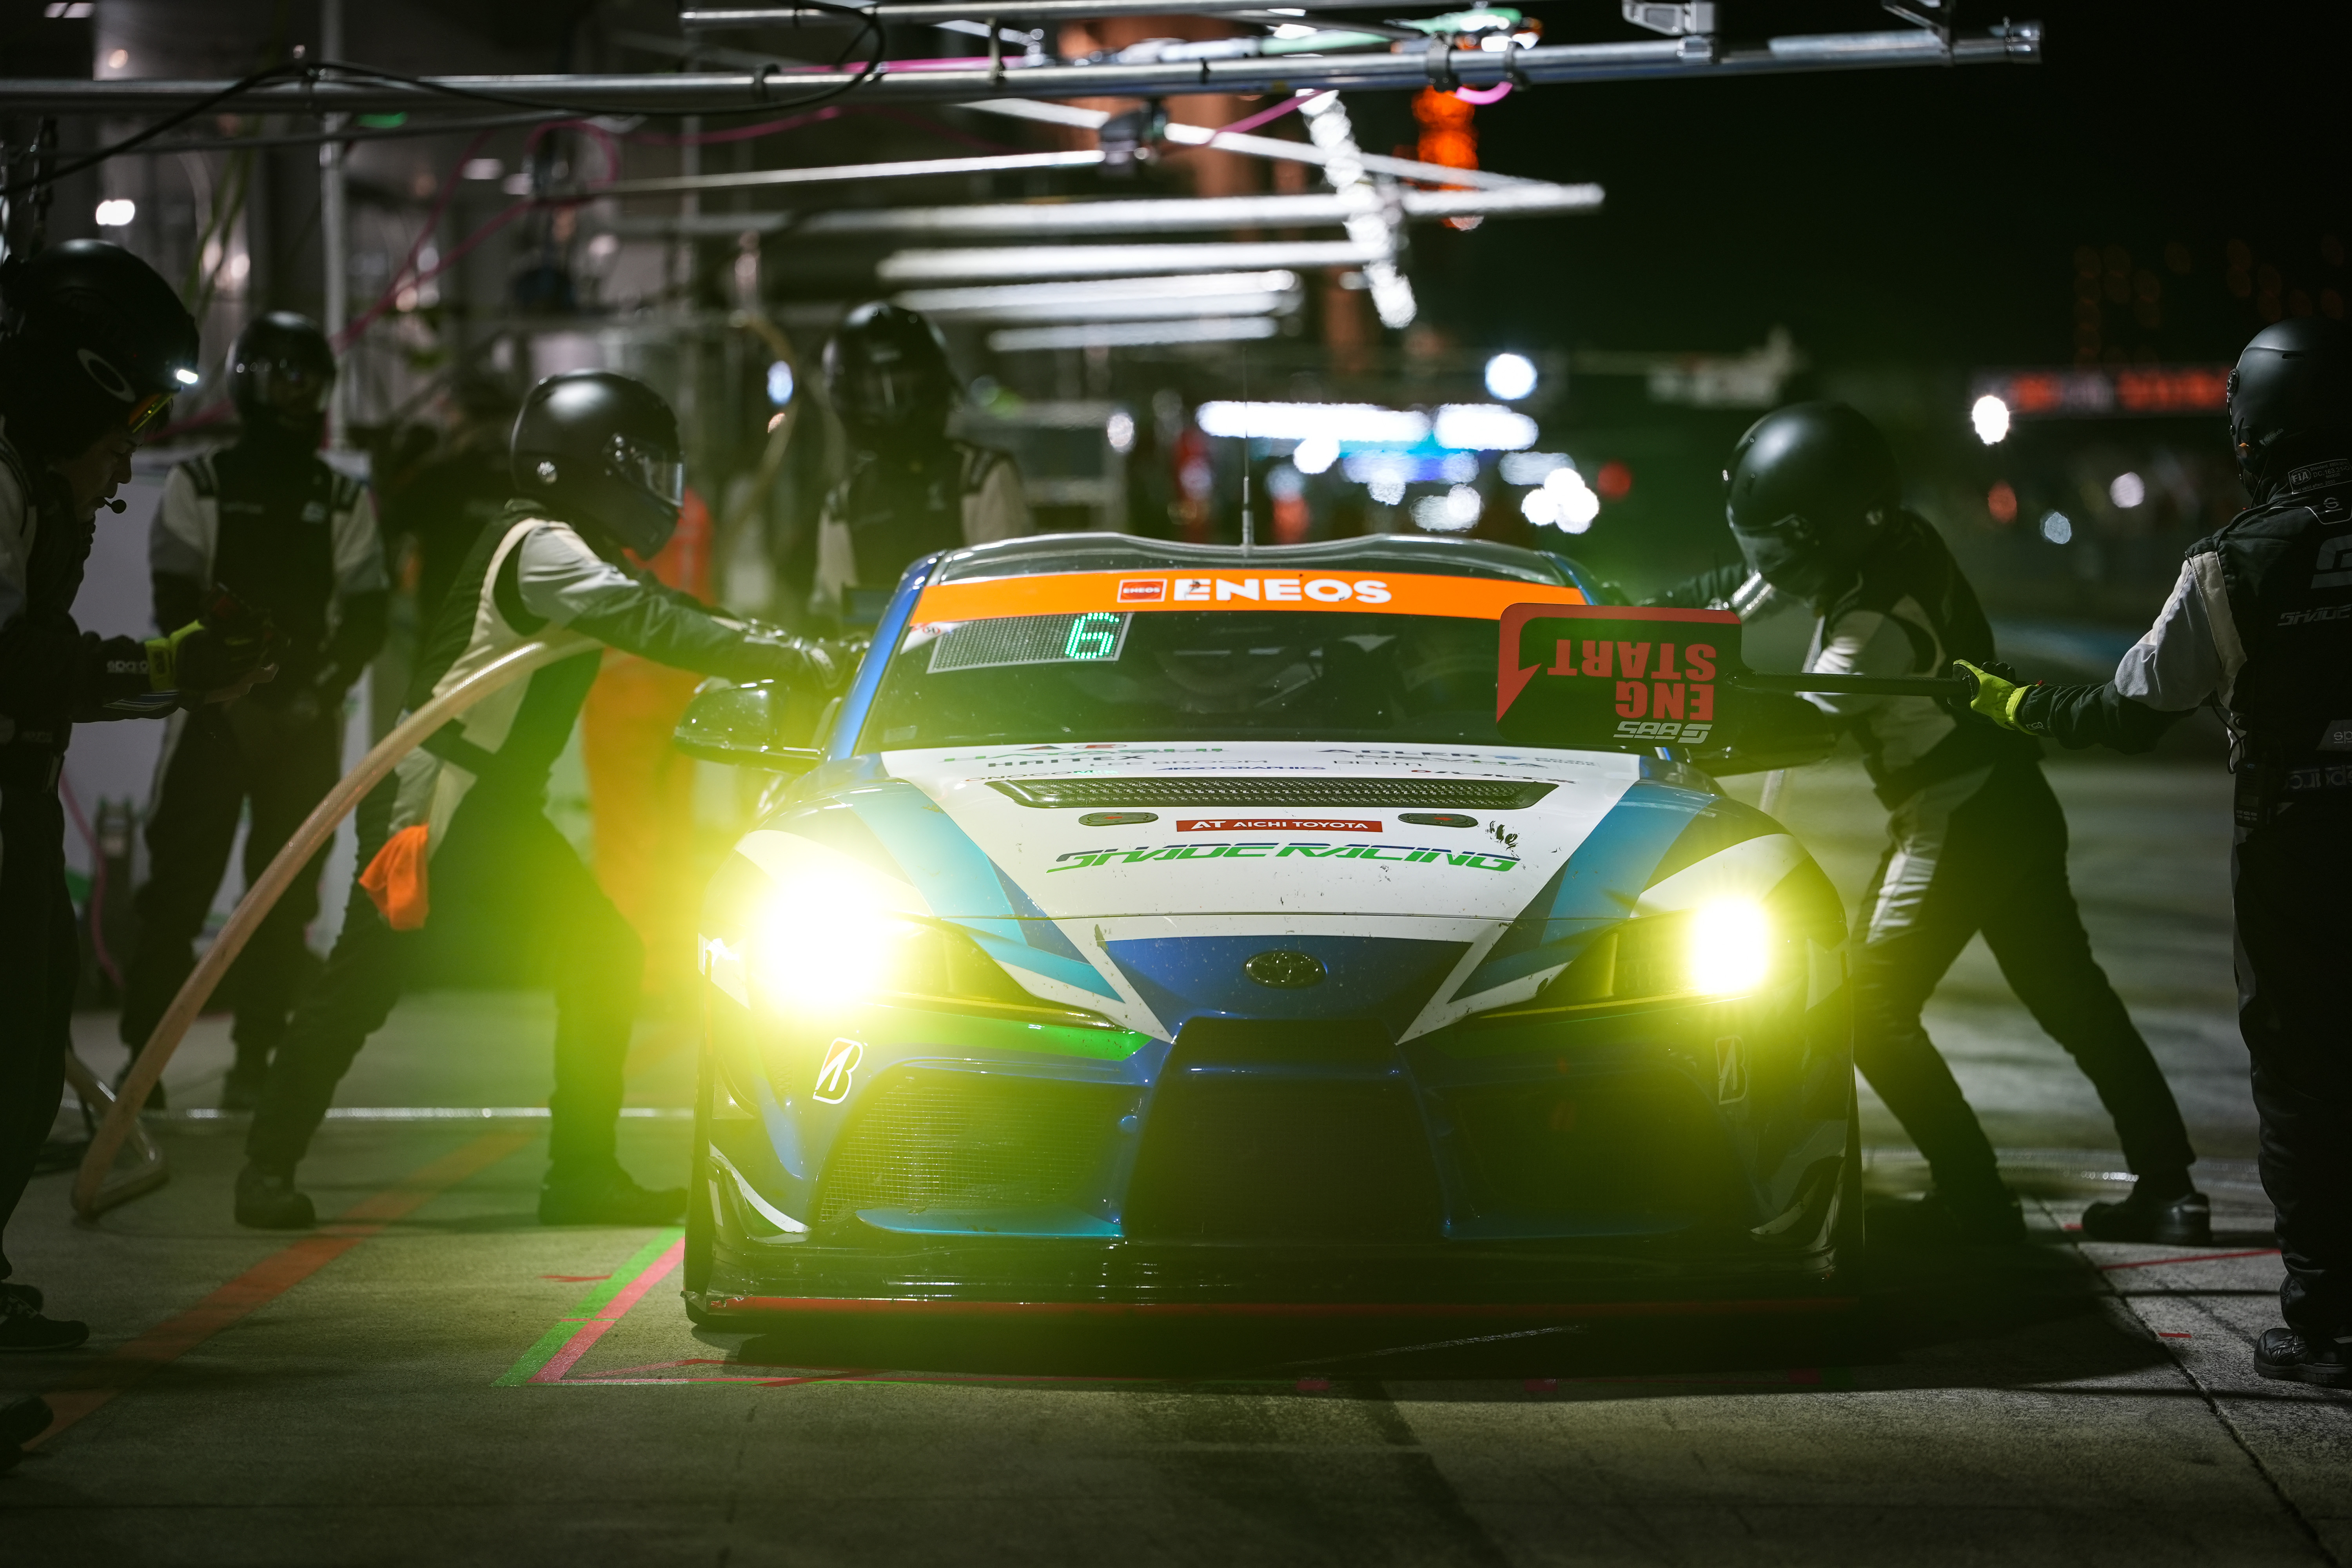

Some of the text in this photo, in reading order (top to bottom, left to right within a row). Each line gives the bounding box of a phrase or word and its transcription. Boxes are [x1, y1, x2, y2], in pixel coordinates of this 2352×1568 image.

[2292, 472, 2309, 483] FIA
[1173, 578, 1393, 604] ENEOS
[1065, 612, 1120, 659] 6
[1547, 639, 1717, 681] START
[1615, 681, 1714, 721] ENG
[988, 755, 1147, 768] HAITEX
[1317, 750, 1480, 758] ADLER
[965, 770, 1094, 781] ONOCOM
[1191, 820, 1227, 829] AT
[1045, 842, 1521, 874] SHADE RACING
